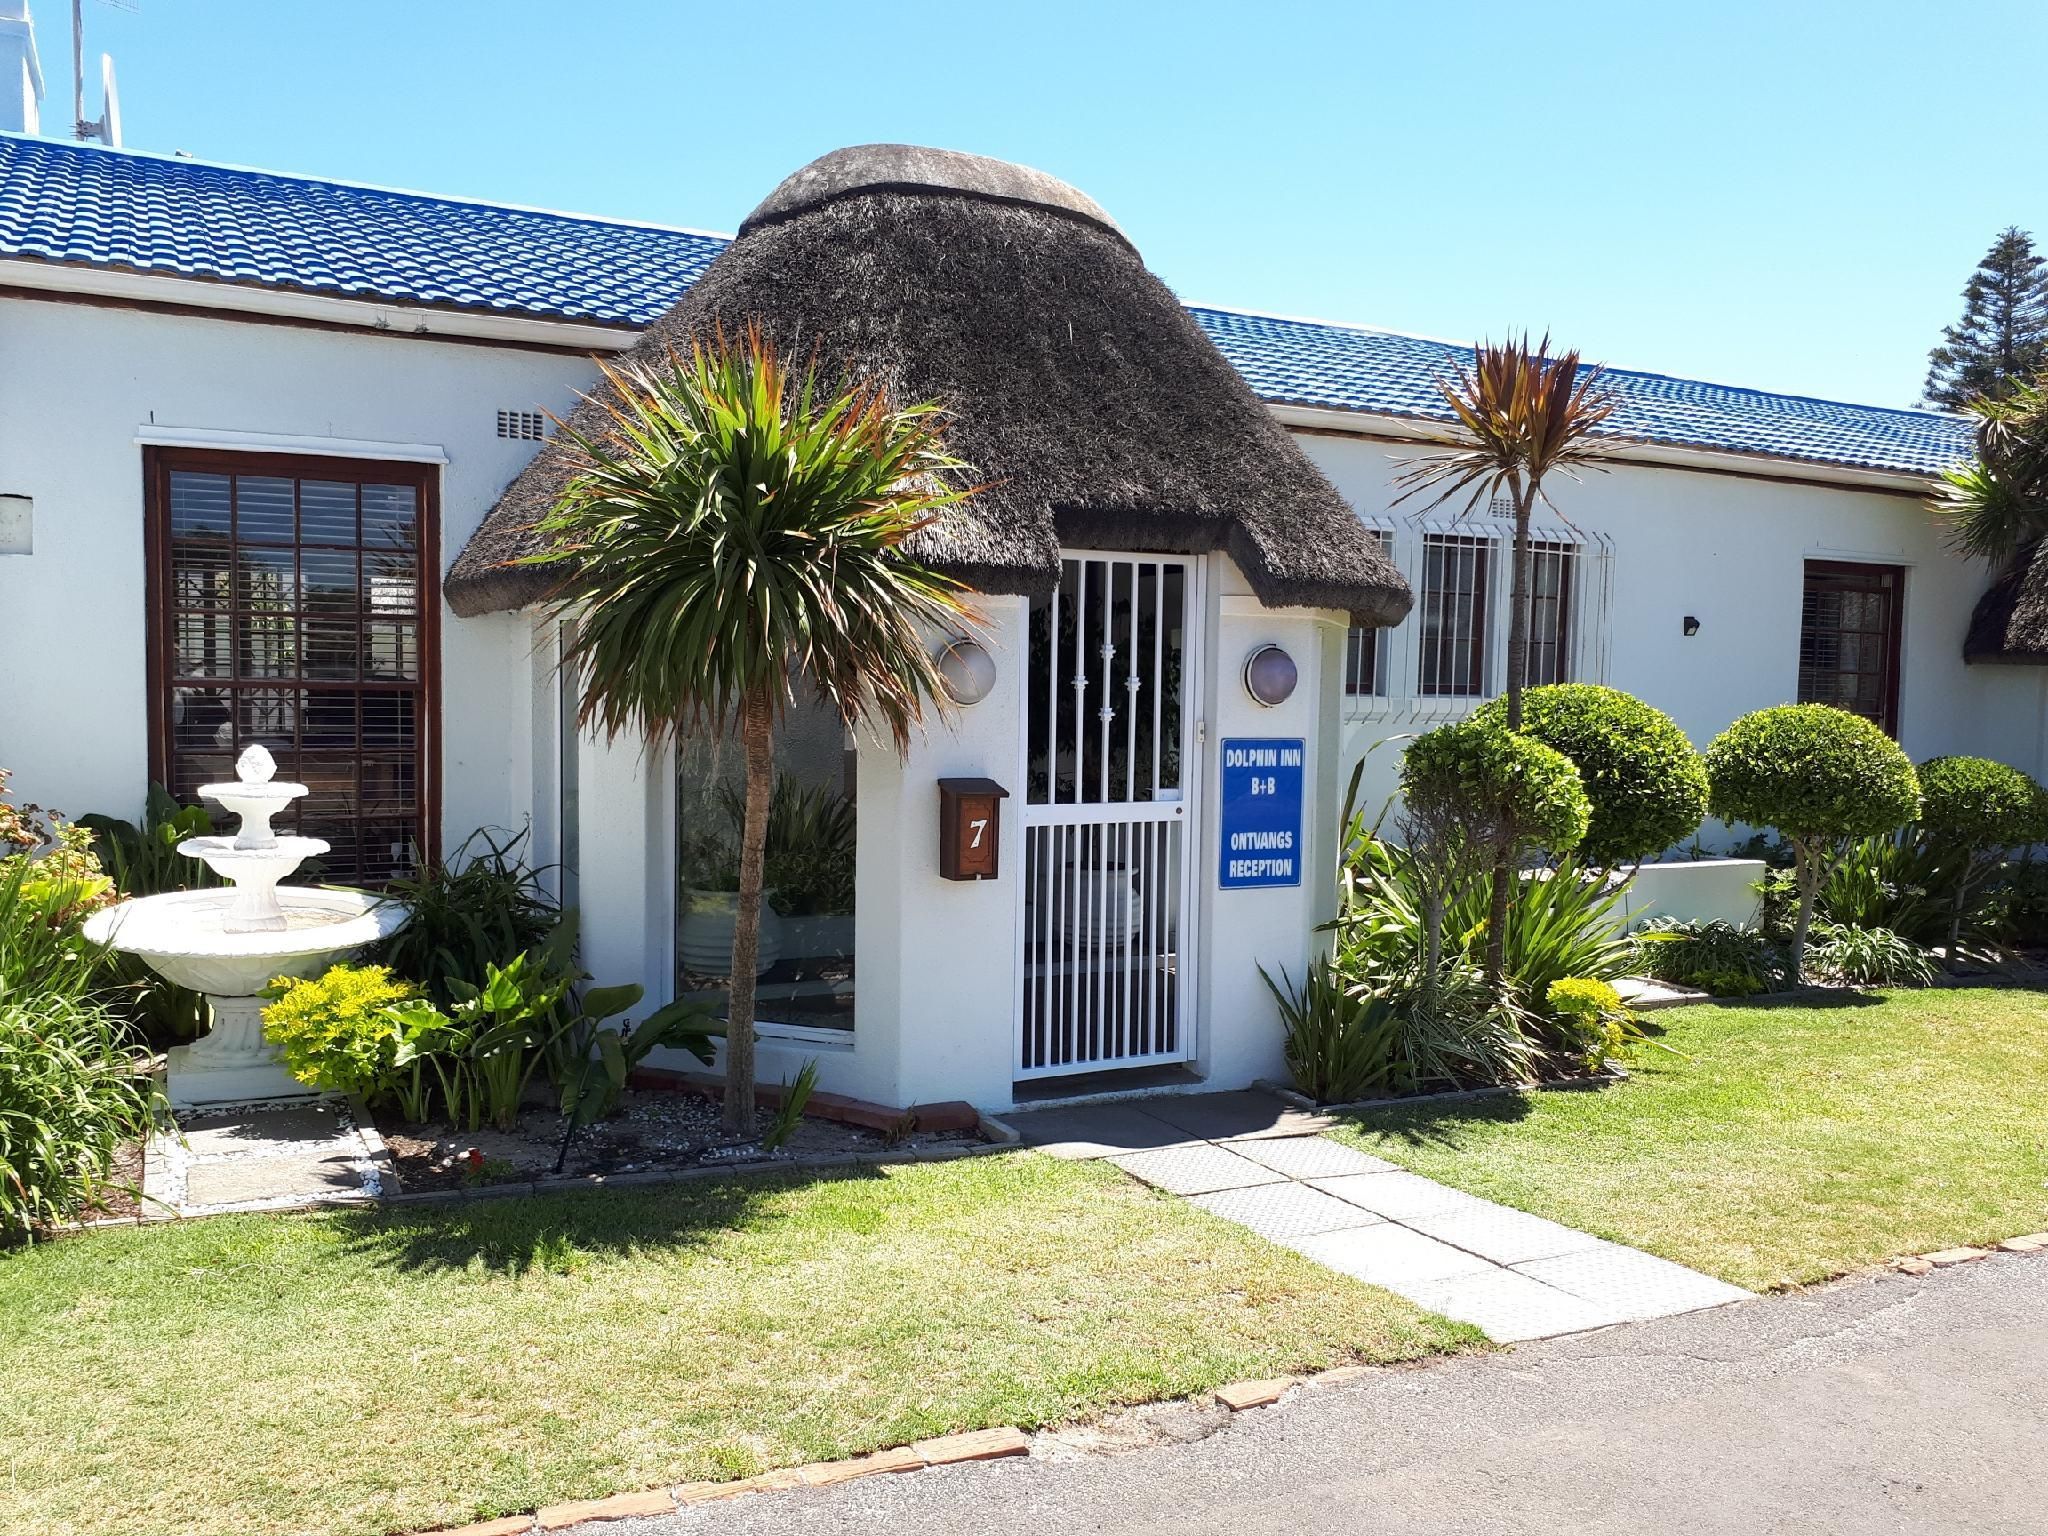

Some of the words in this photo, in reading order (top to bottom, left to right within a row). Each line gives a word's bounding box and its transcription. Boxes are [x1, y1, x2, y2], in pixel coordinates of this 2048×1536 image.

[1226, 748, 1277, 768] DOLPHIN
[1280, 748, 1301, 767] INN
[1251, 777, 1276, 795] B+B
[970, 819, 988, 849] 7
[1230, 831, 1293, 851] ONTVANGS
[1229, 858, 1293, 878] RECEPTION
